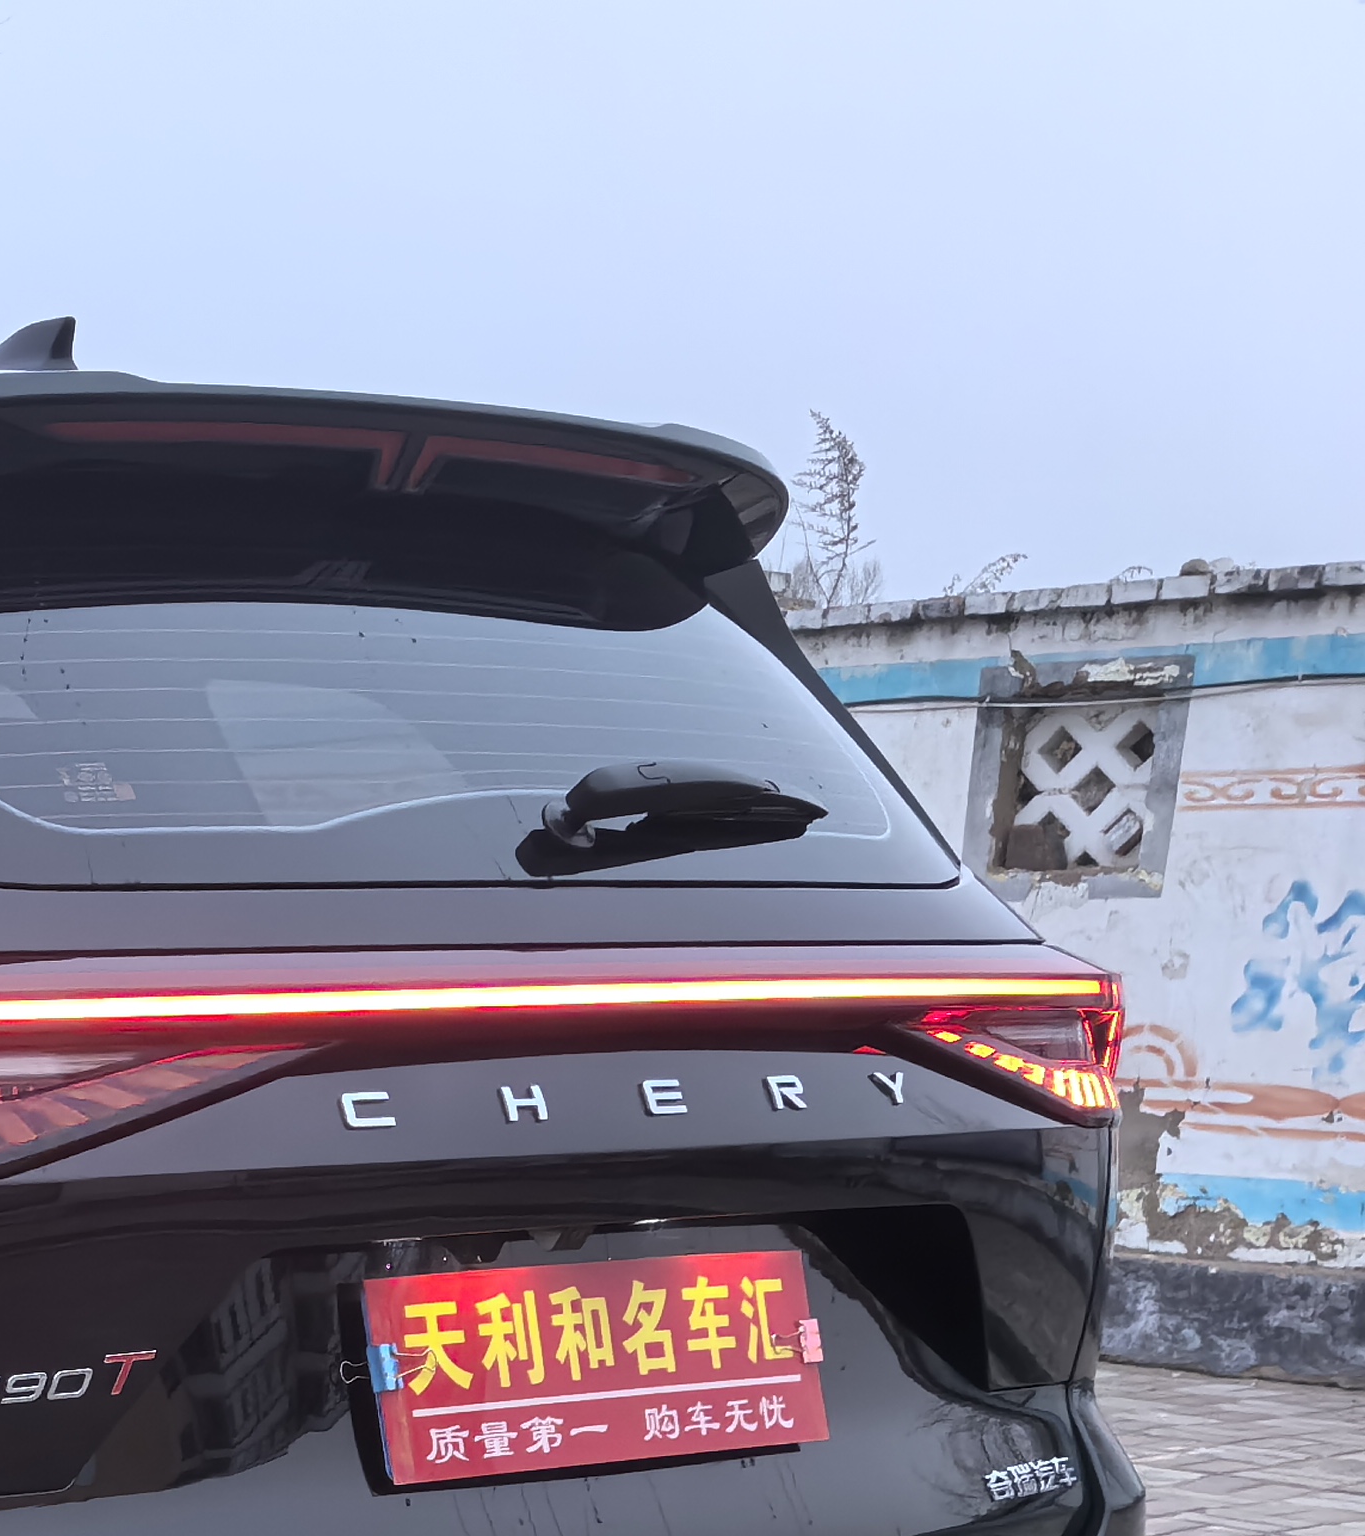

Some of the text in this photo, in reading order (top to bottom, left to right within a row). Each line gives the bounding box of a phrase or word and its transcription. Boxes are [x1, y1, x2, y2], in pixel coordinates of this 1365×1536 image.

[342, 1071, 904, 1128] CHERY
[403, 1276, 794, 1395] 天利和名车汇
[426, 1395, 796, 1464] 质量第一 购车无忧
